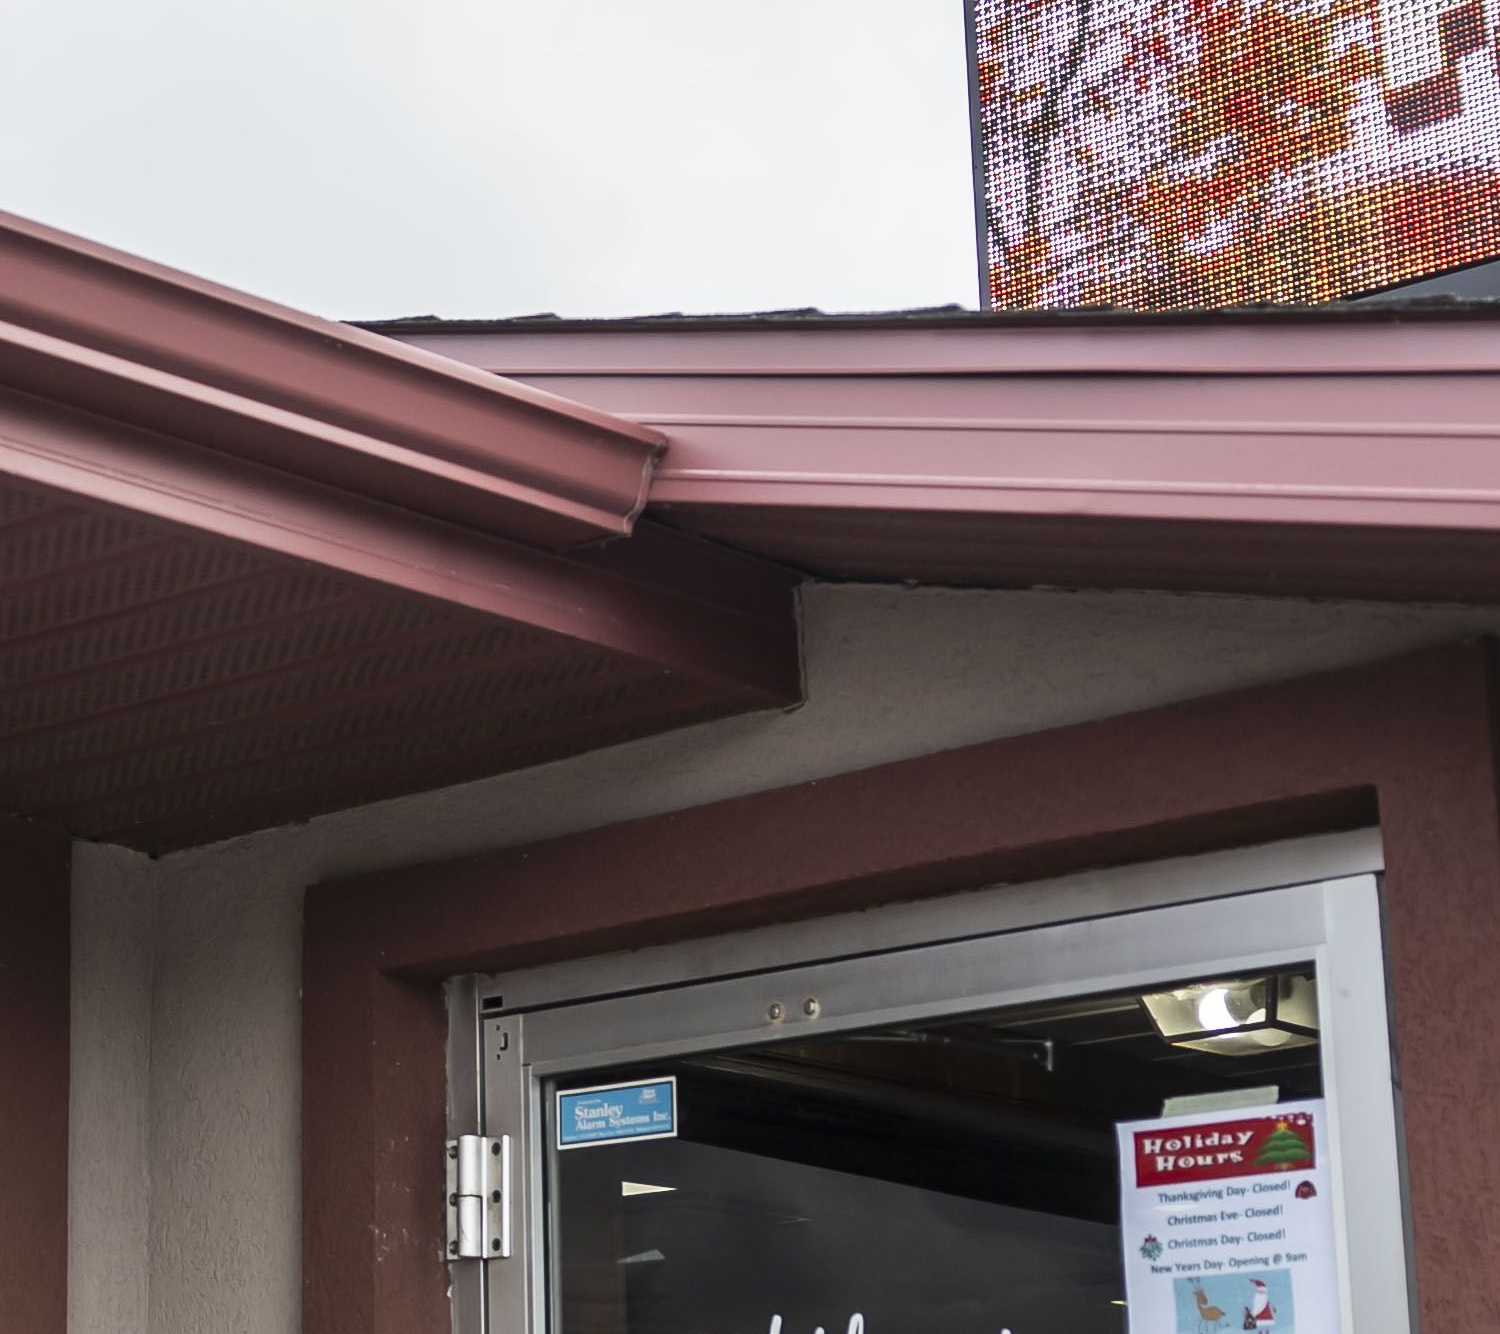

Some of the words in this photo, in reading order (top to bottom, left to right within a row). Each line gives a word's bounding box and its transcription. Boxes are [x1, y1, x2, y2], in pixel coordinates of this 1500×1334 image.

[574, 1102, 624, 1120] Stanley
[575, 1119, 606, 1131] Alarm
[608, 1114, 650, 1128] Systems
[652, 1110, 671, 1122] Inc.
[1142, 1131, 1254, 1155] Holiday
[1155, 1150, 1244, 1172] Hours
[1158, 1187, 1223, 1203] Thanksgiving
[1252, 1179, 1291, 1194] Closed!
[1167, 1213, 1218, 1227] Christmas
[1245, 1204, 1283, 1219] Closed!
[1167, 1236, 1218, 1250] Christmas
[1247, 1228, 1286, 1243] Closed!
[1151, 1264, 1172, 1274] New
[1228, 1256, 1269, 1269] Opening
[1272, 1253, 1282, 1265] @
[1285, 1251, 1308, 1263] 9am
